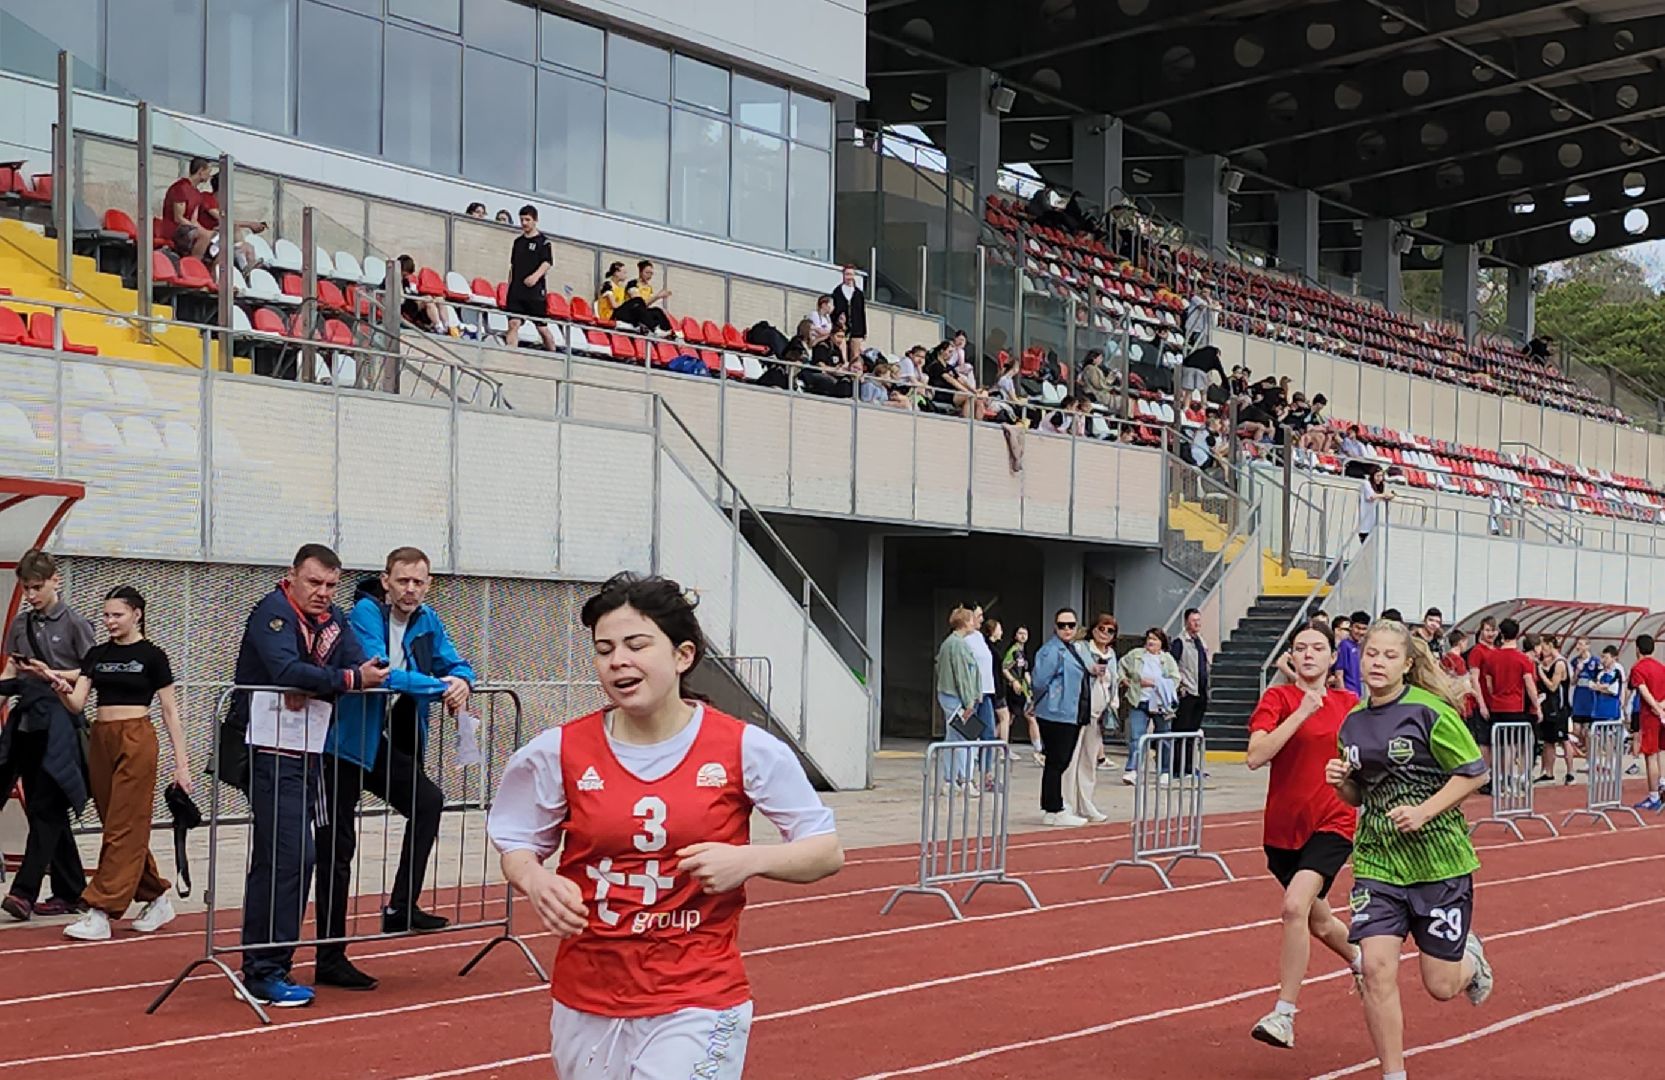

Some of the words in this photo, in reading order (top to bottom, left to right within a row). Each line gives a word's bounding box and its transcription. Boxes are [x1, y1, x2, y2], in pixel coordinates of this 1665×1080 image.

[632, 796, 667, 852] 3
[631, 909, 700, 933] group
[1427, 907, 1462, 941] 29
